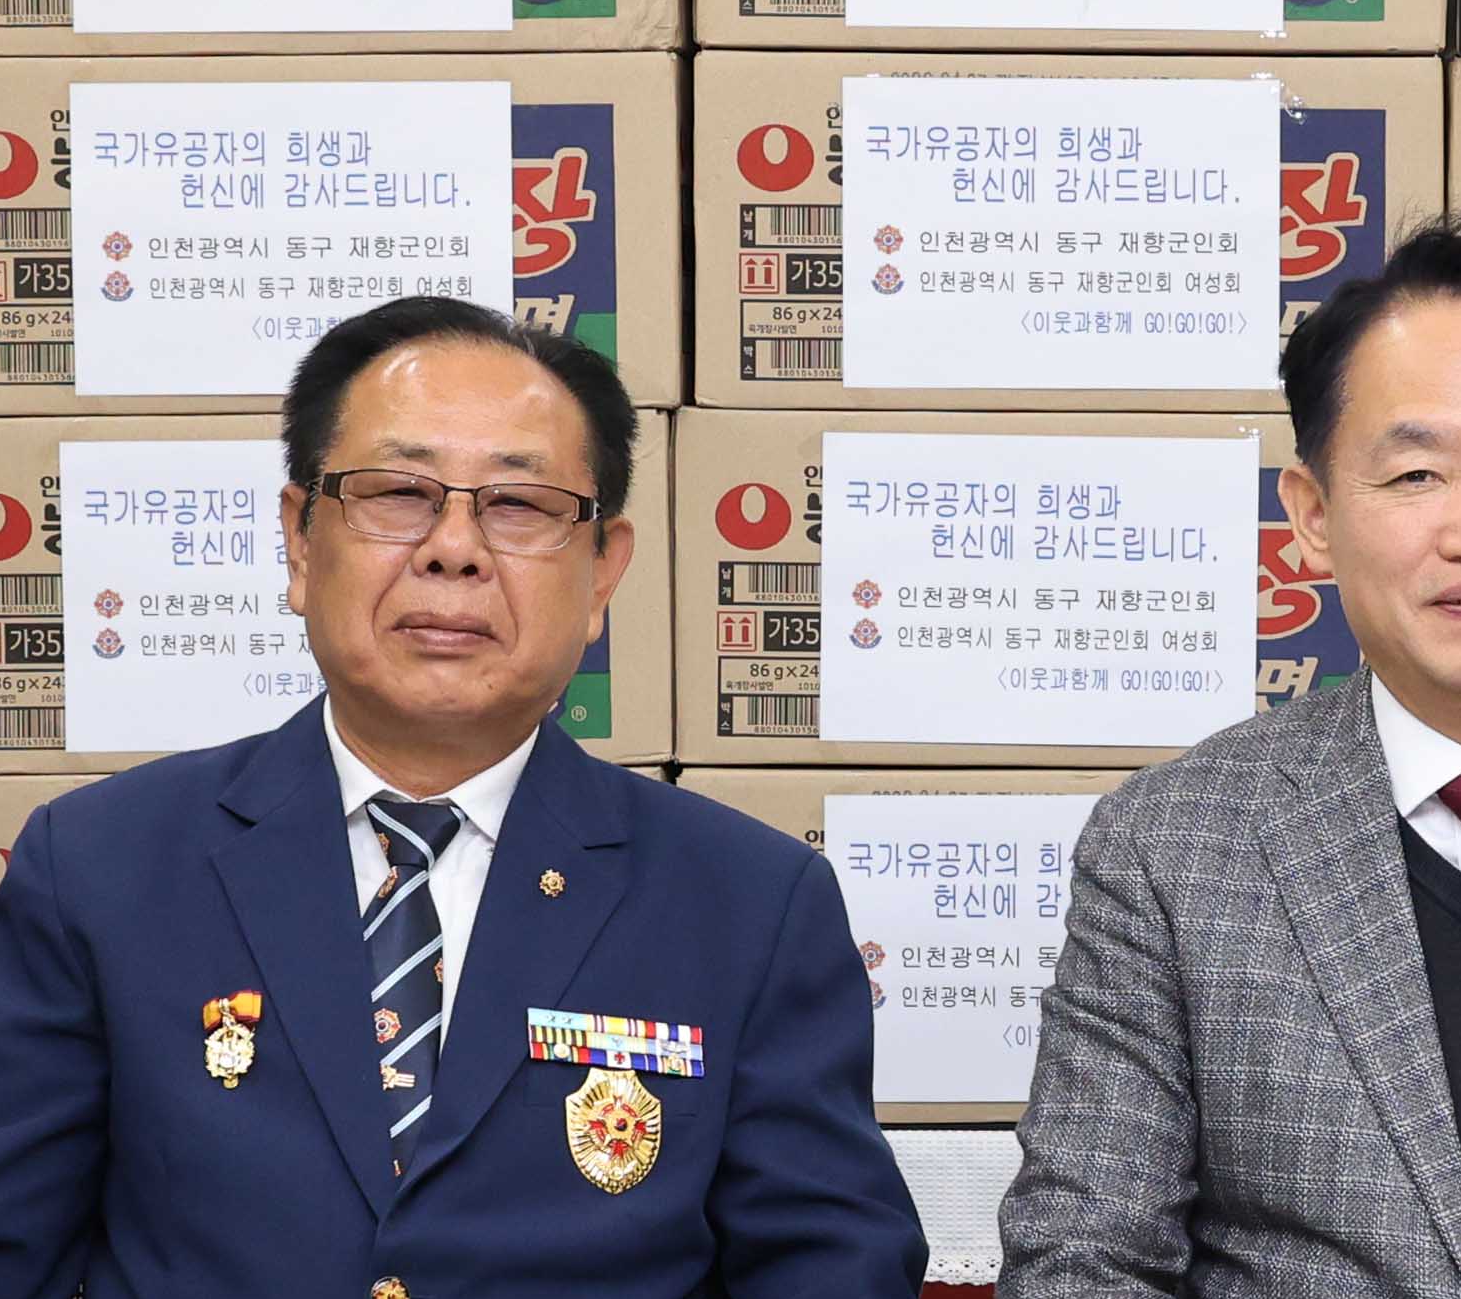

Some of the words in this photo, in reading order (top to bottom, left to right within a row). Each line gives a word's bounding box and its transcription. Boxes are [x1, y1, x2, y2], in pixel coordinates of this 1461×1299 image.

[95, 132, 264, 167] 국가유공자의
[287, 132, 371, 167] 희생과
[867, 126, 1036, 162] 국가유공자의
[1058, 128, 1142, 162] 희생과
[182, 174, 263, 208] 헌신에
[285, 174, 470, 207] 감사드립니다.
[953, 168, 1034, 202] 헌신에
[1056, 169, 1239, 203] 감사드립니다.
[149, 238, 268, 259] 인천광역시
[287, 237, 331, 258] 동구
[350, 237, 468, 258] 재향군인회
[920, 232, 1038, 253] 인천광역시
[1057, 232, 1102, 253] 동구
[1119, 232, 1237, 253] 재향군인회
[150, 278, 244, 299] 인천광역시
[259, 278, 294, 299] 동구
[309, 277, 402, 298] 재향군인회
[417, 277, 471, 300] 여성회
[921, 272, 1013, 293] 인천광역시
[1029, 272, 1063, 293] 동구
[1078, 272, 1171, 293] 재향군인회
[1186, 273, 1239, 293] 여성회
[85, 490, 254, 525] 국가유공자의
[847, 482, 1015, 518] 국가유공자의
[1037, 485, 1121, 520] 희생과
[172, 531, 253, 566] 헌신에
[932, 525, 1013, 559] 헌신에
[1035, 526, 1217, 561] 감사드립니다.
[140, 595, 258, 616] 인천광역시
[898, 587, 1016, 609] 인천광역시
[1035, 589, 1079, 610] 동구
[1097, 590, 1214, 611] 재향군인회
[141, 635, 234, 656] 인천광역시
[250, 634, 285, 655] 동구
[898, 627, 991, 648] 인천광역시
[1006, 628, 1040, 649] 동구
[1055, 629, 1148, 650] 재향군인회
[1163, 631, 1216, 652] 여성회
[848, 843, 1017, 878] 국가유공자의
[934, 884, 1015, 918] 헌신에
[902, 947, 1019, 968] 인천광역시
[903, 987, 995, 1008] 인천광역시
